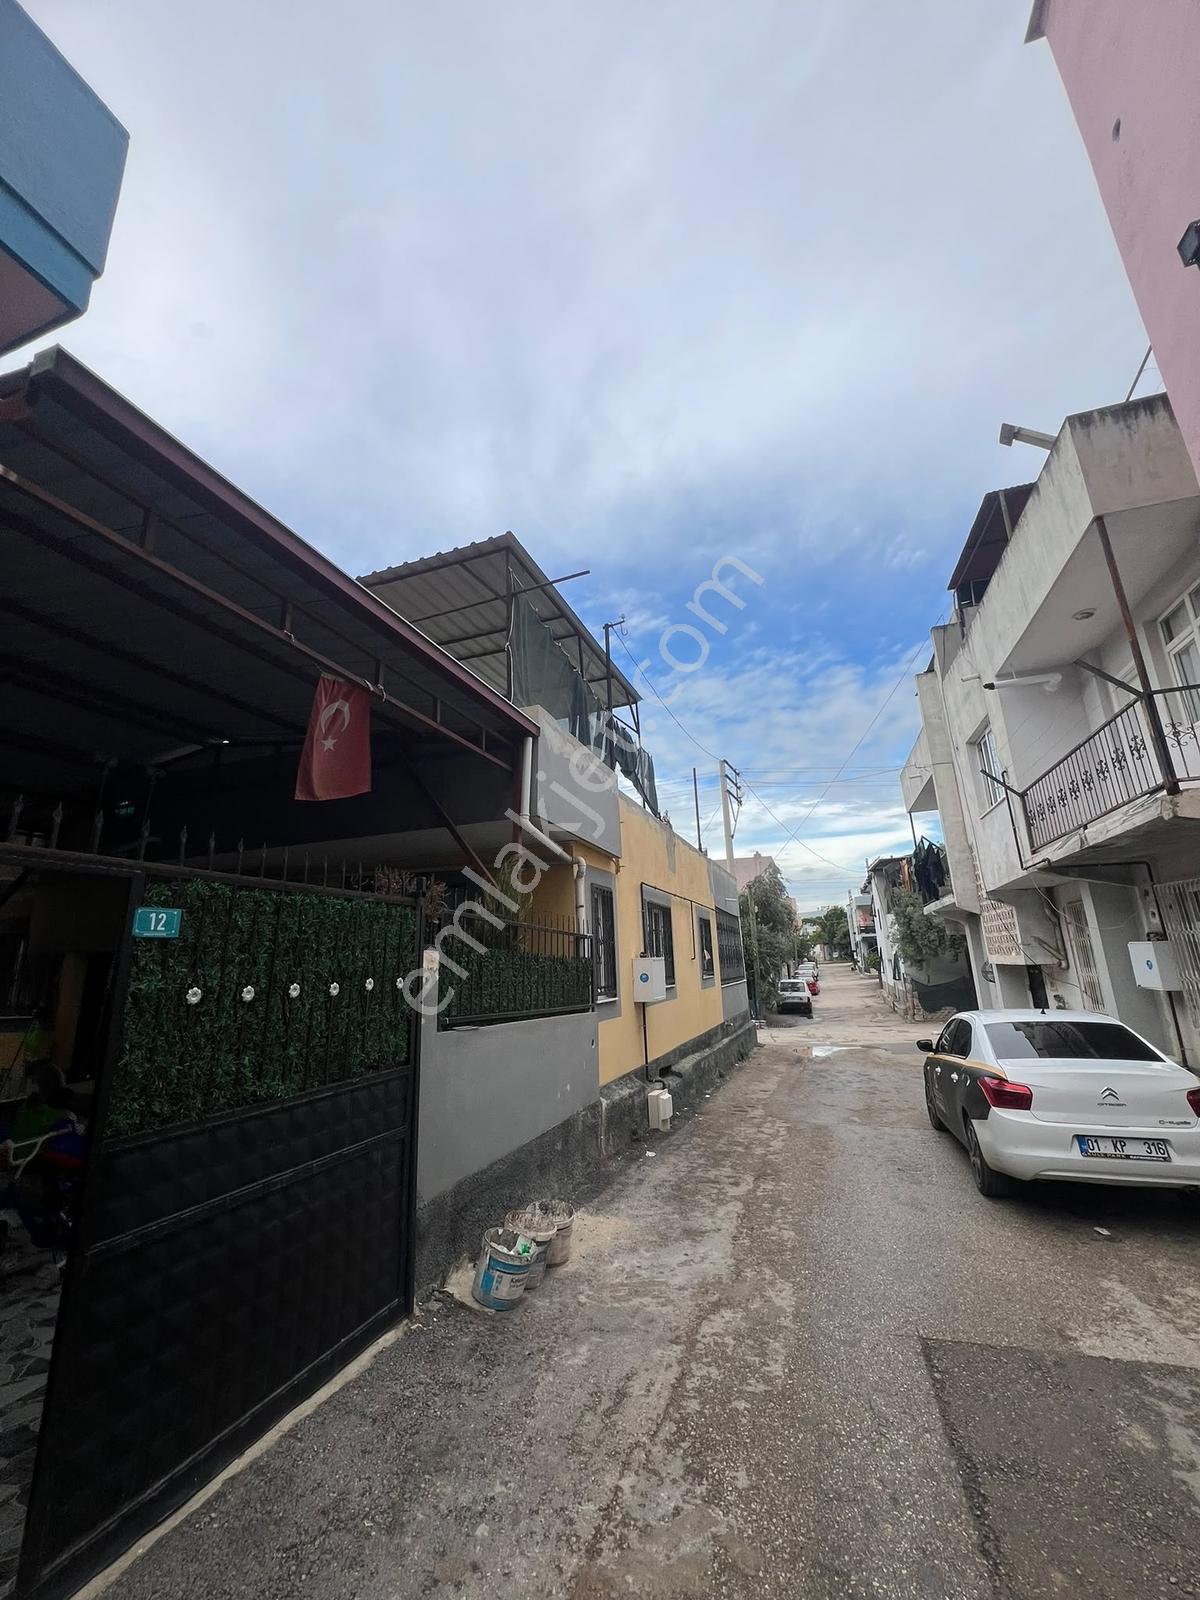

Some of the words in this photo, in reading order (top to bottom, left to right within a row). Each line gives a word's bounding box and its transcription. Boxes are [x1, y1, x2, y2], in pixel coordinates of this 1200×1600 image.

[149, 912, 167, 931] 12
[1087, 1138, 1101, 1152] 01
[1112, 1139, 1127, 1153] KP
[1143, 1141, 1166, 1156] 316
